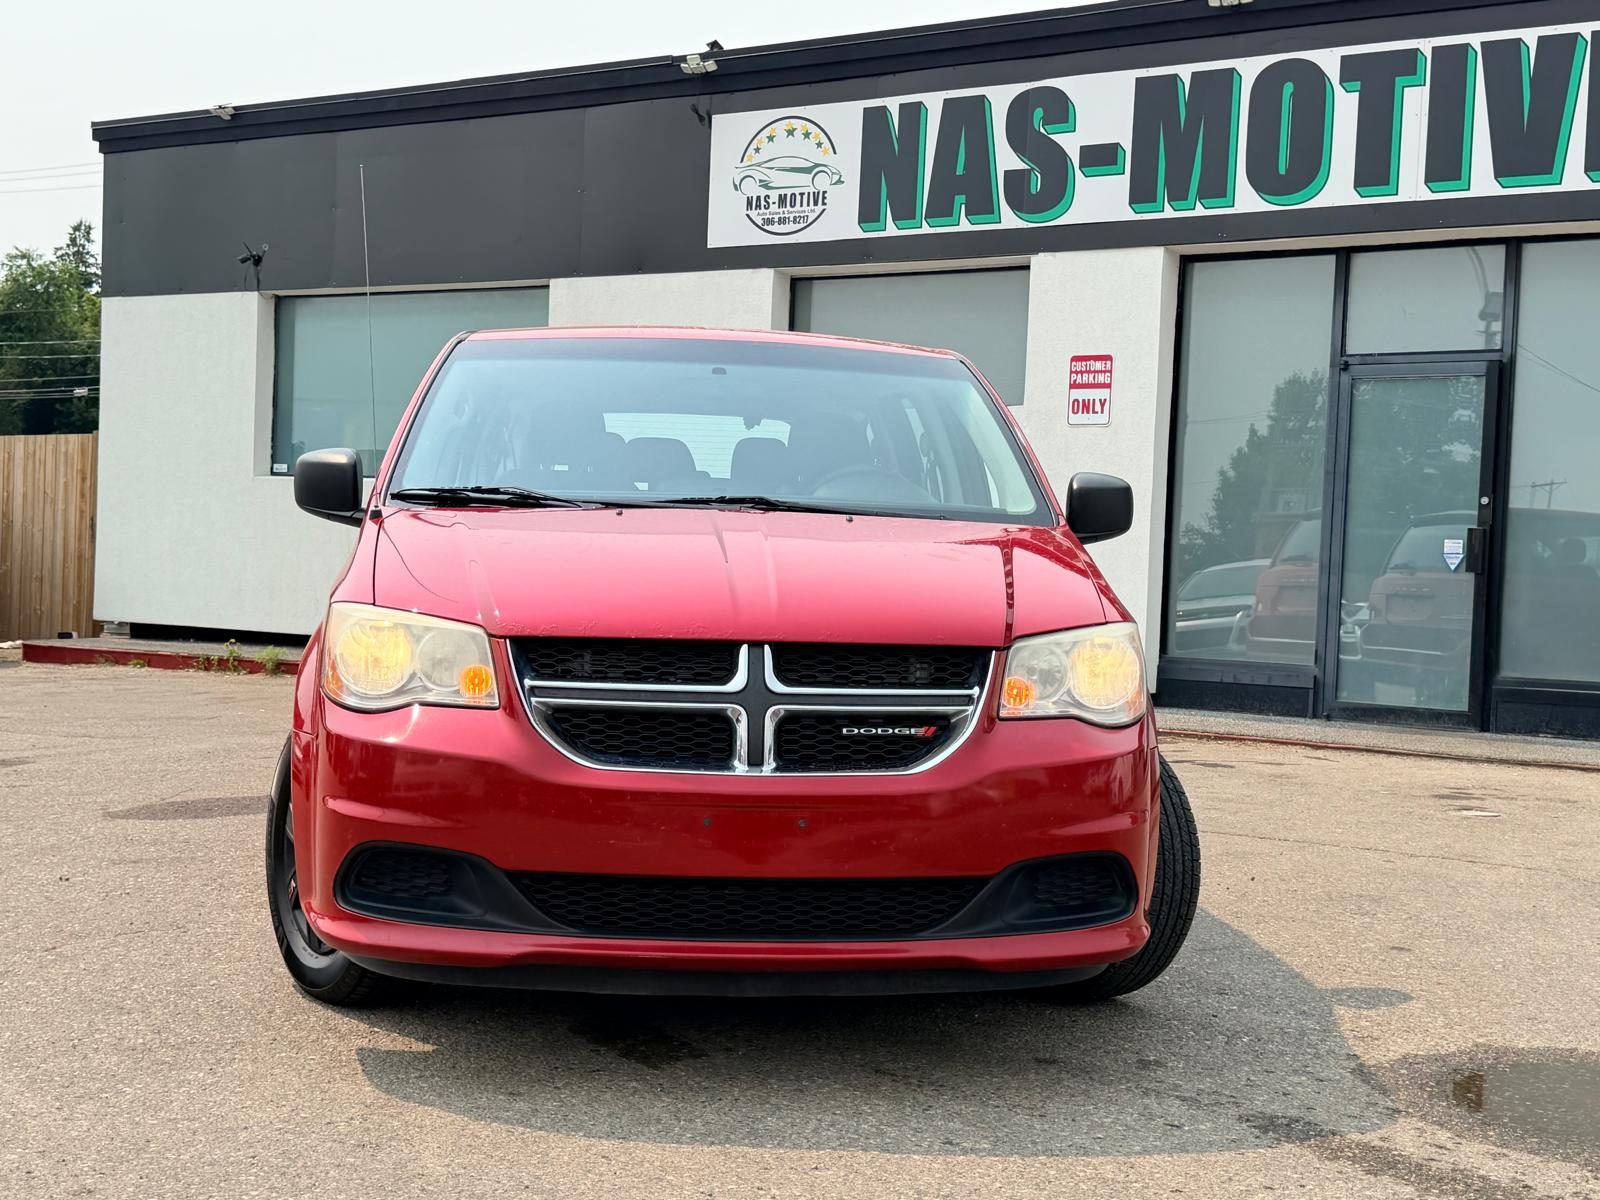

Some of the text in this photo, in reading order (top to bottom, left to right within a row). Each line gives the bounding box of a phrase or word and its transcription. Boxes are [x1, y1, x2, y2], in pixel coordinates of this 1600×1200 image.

[746, 190, 827, 211] NAS-MOTIVE
[761, 215, 809, 226] 306-881-8217
[1071, 360, 1111, 371] CUSTOMER
[1070, 373, 1111, 384] PARKING
[1071, 398, 1107, 415] ONLY
[842, 727, 924, 735] DODGE
